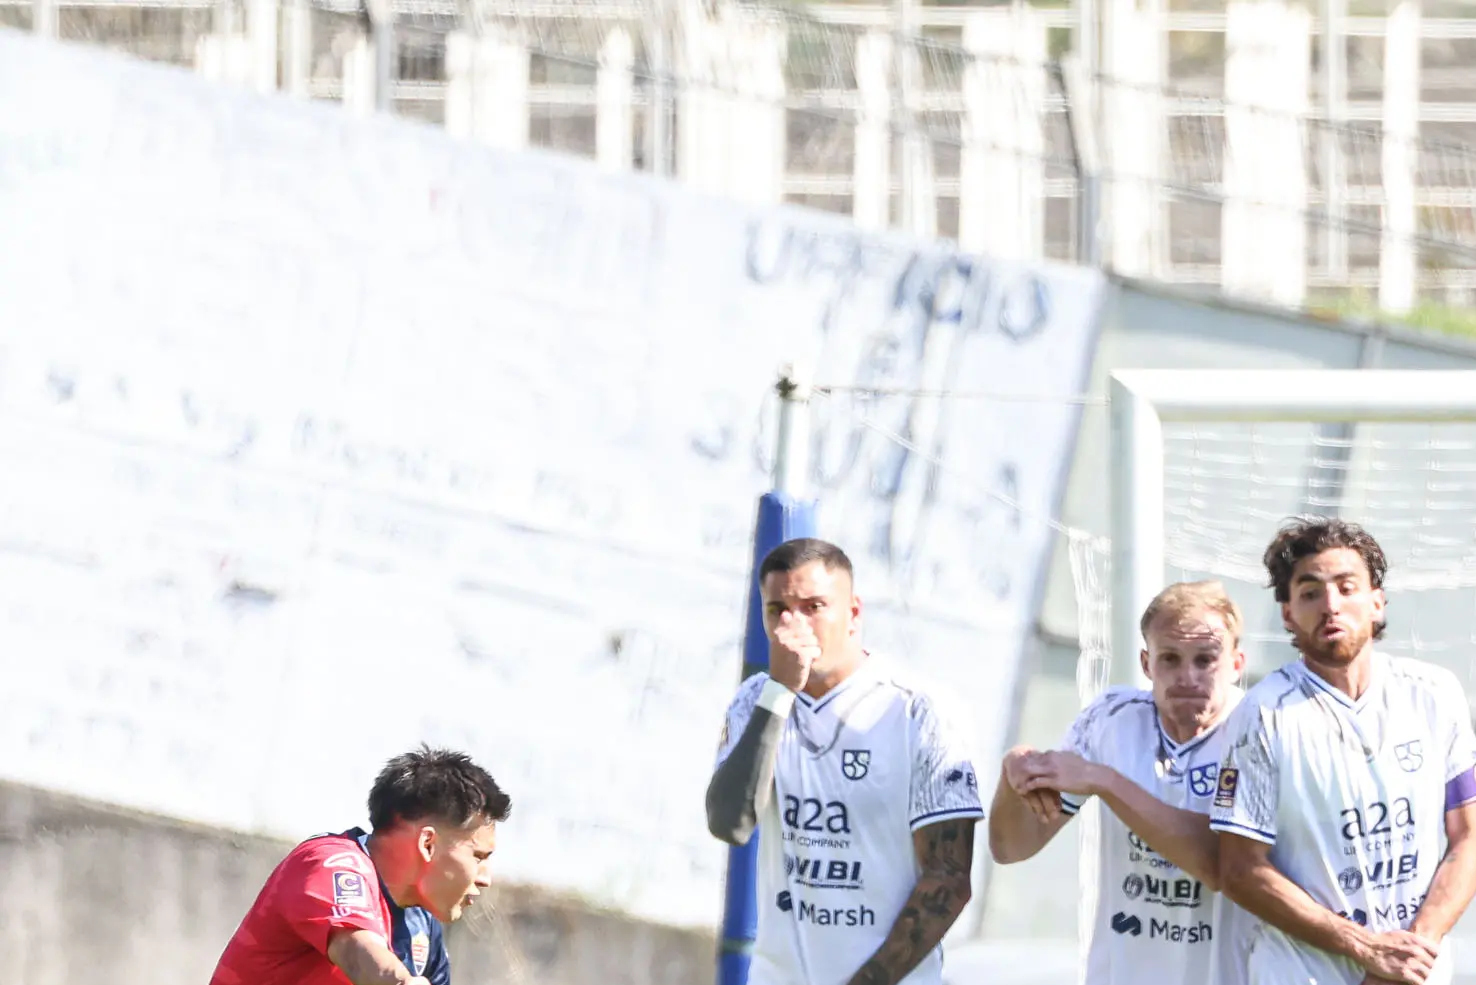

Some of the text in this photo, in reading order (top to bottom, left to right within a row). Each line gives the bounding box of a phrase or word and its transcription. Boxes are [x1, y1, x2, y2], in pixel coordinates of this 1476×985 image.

[783, 794, 851, 834] a2a
[1340, 797, 1416, 841] a2a
[795, 856, 862, 881] VIBI
[1145, 874, 1202, 900] VIBI
[799, 900, 875, 926] Marsh
[1149, 917, 1213, 944] Marsh
